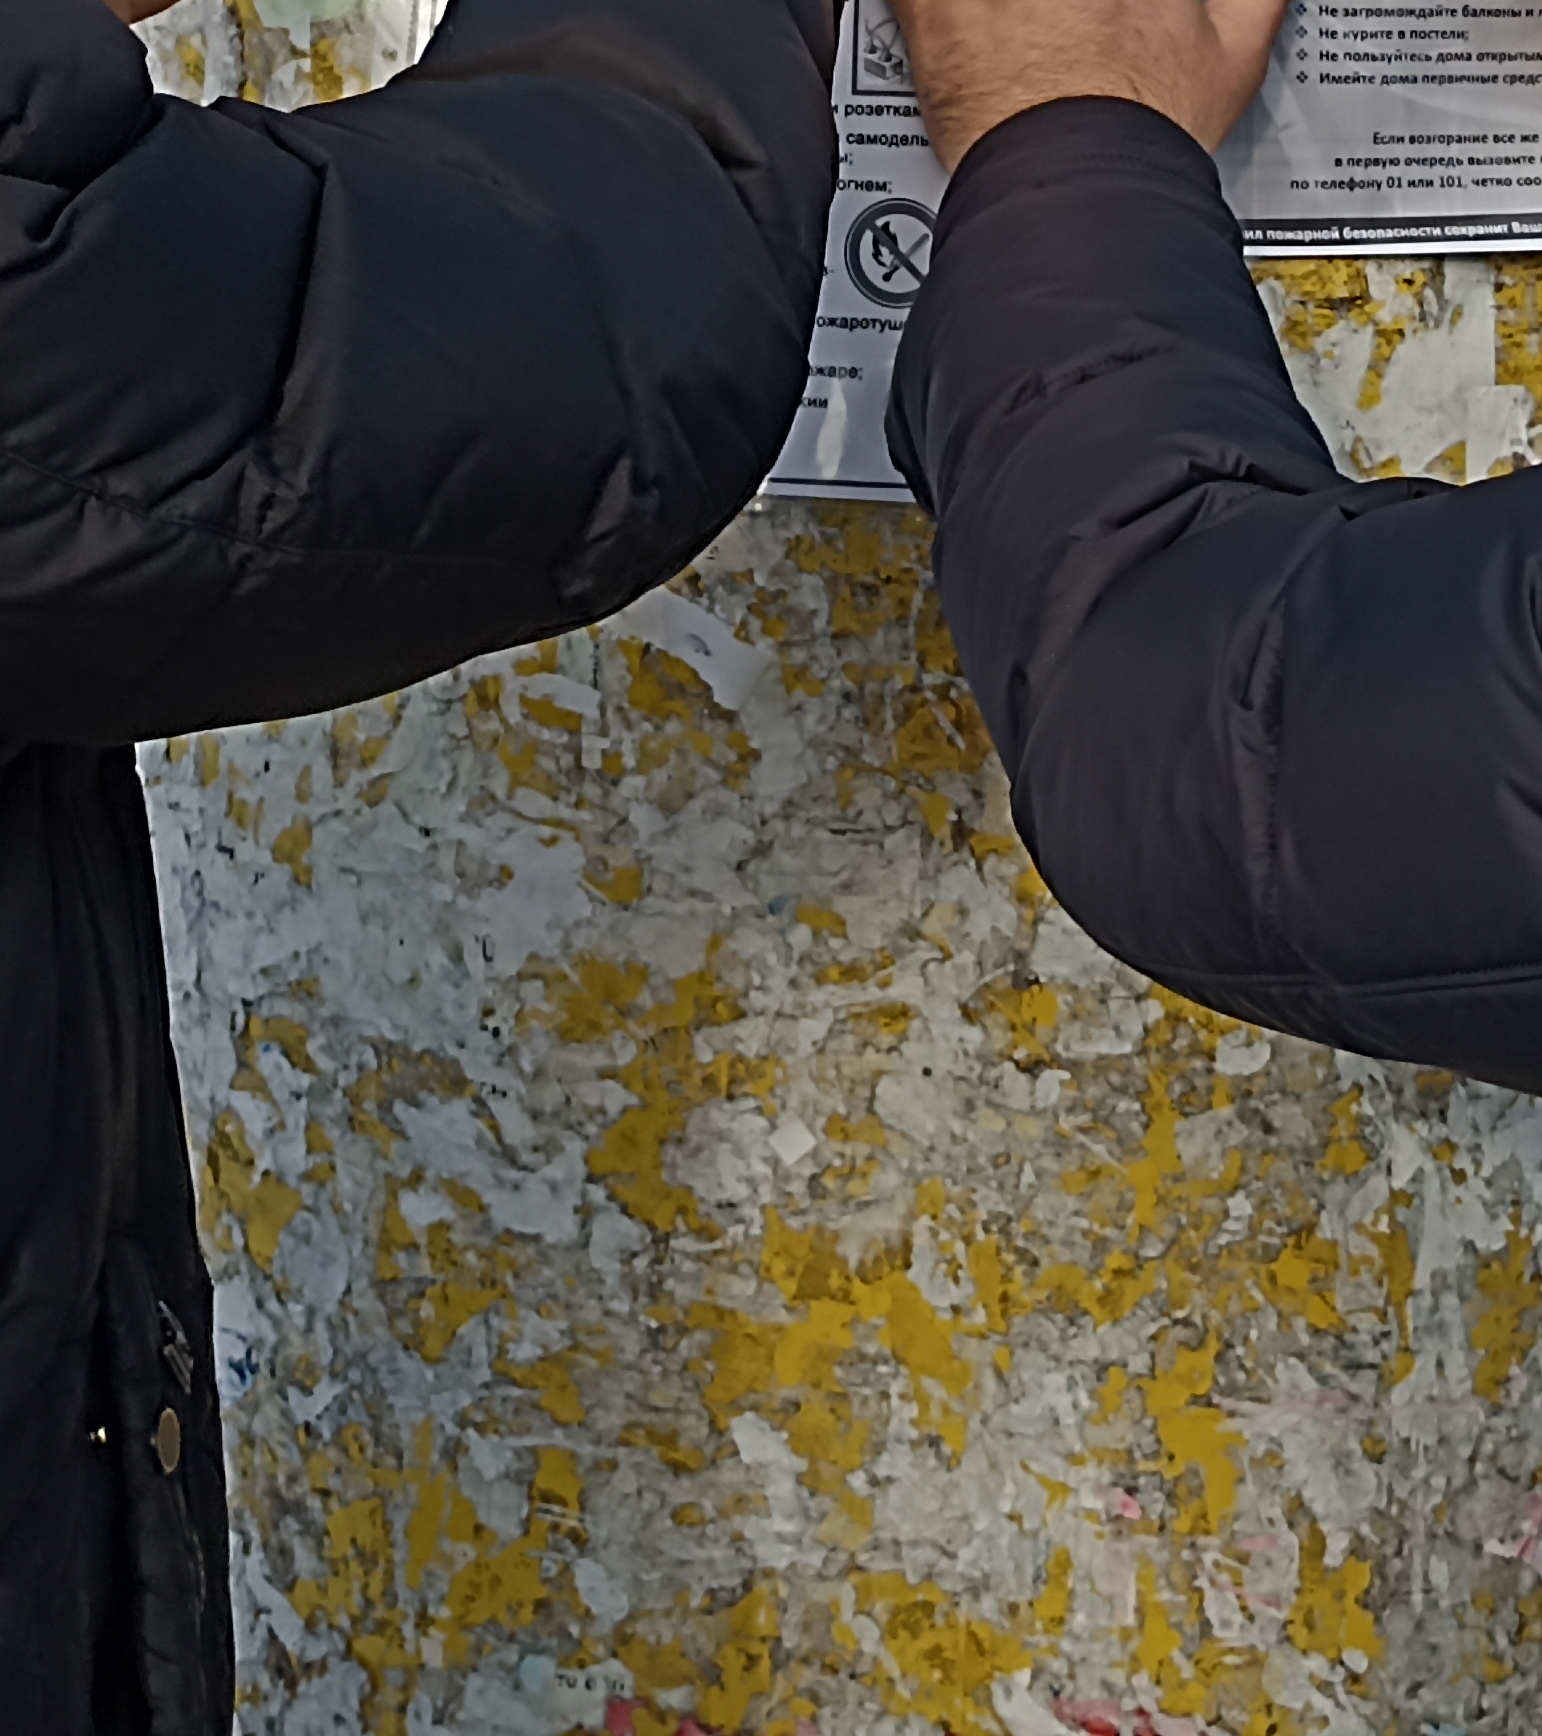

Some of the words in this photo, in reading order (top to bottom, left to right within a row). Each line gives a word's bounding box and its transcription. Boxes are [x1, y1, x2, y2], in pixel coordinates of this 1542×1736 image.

[1318, 5, 1339, 18] Не
[1343, 5, 1458, 20] загромождайте
[1461, 4, 1522, 18] балконы
[1525, 8, 1534, 18] и
[1319, 27, 1339, 40] Не
[1343, 29, 1394, 42] курите
[1397, 31, 1406, 40] в
[1319, 49, 1339, 62] Не
[1343, 49, 1433, 65] пользуйтесь
[1436, 52, 1473, 65] дома
[1319, 71, 1376, 85] Имейте
[1380, 74, 1418, 87] дома
[1421, 74, 1499, 88] первичные
[1373, 131, 1405, 146] Если
[1408, 134, 1489, 148] возгорание
[1492, 133, 1516, 144] все
[1520, 133, 1540, 144] же
[1334, 157, 1343, 167] в
[1346, 156, 1401, 171] первую
[1404, 155, 1464, 169] очередь
[1467, 155, 1536, 167] вызовите
[1290, 179, 1310, 192] по
[1313, 176, 1384, 194] телефону
[1386, 177, 1403, 189] 01
[1406, 178, 1435, 190] или
[1471, 175, 1513, 188] четко
[1266, 225, 1340, 243] пожарной
[1342, 224, 1442, 240] безопасности
[1444, 222, 1508, 238] сохранит
